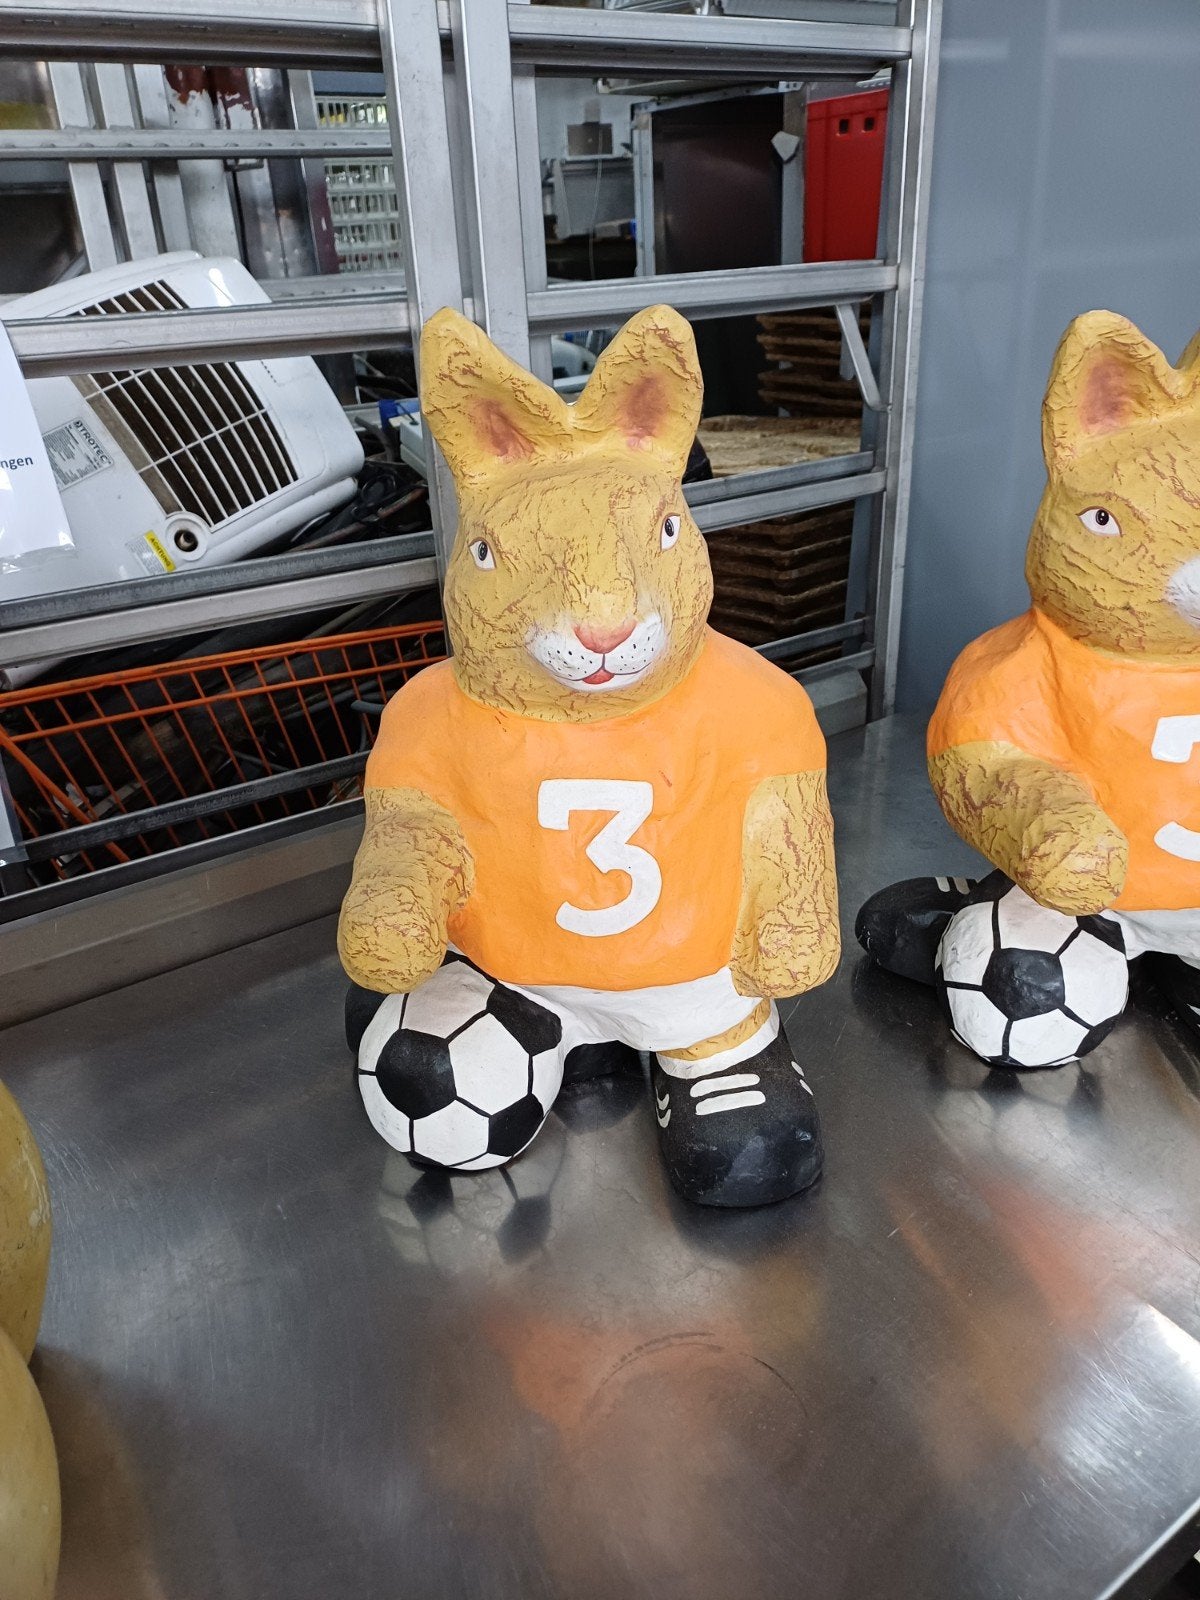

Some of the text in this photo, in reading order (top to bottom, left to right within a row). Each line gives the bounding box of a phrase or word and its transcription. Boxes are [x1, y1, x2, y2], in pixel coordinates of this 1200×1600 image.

[79, 426, 109, 463] TROTEC
[150, 538, 172, 567] ACHTUNG
[537, 778, 662, 937] 3
